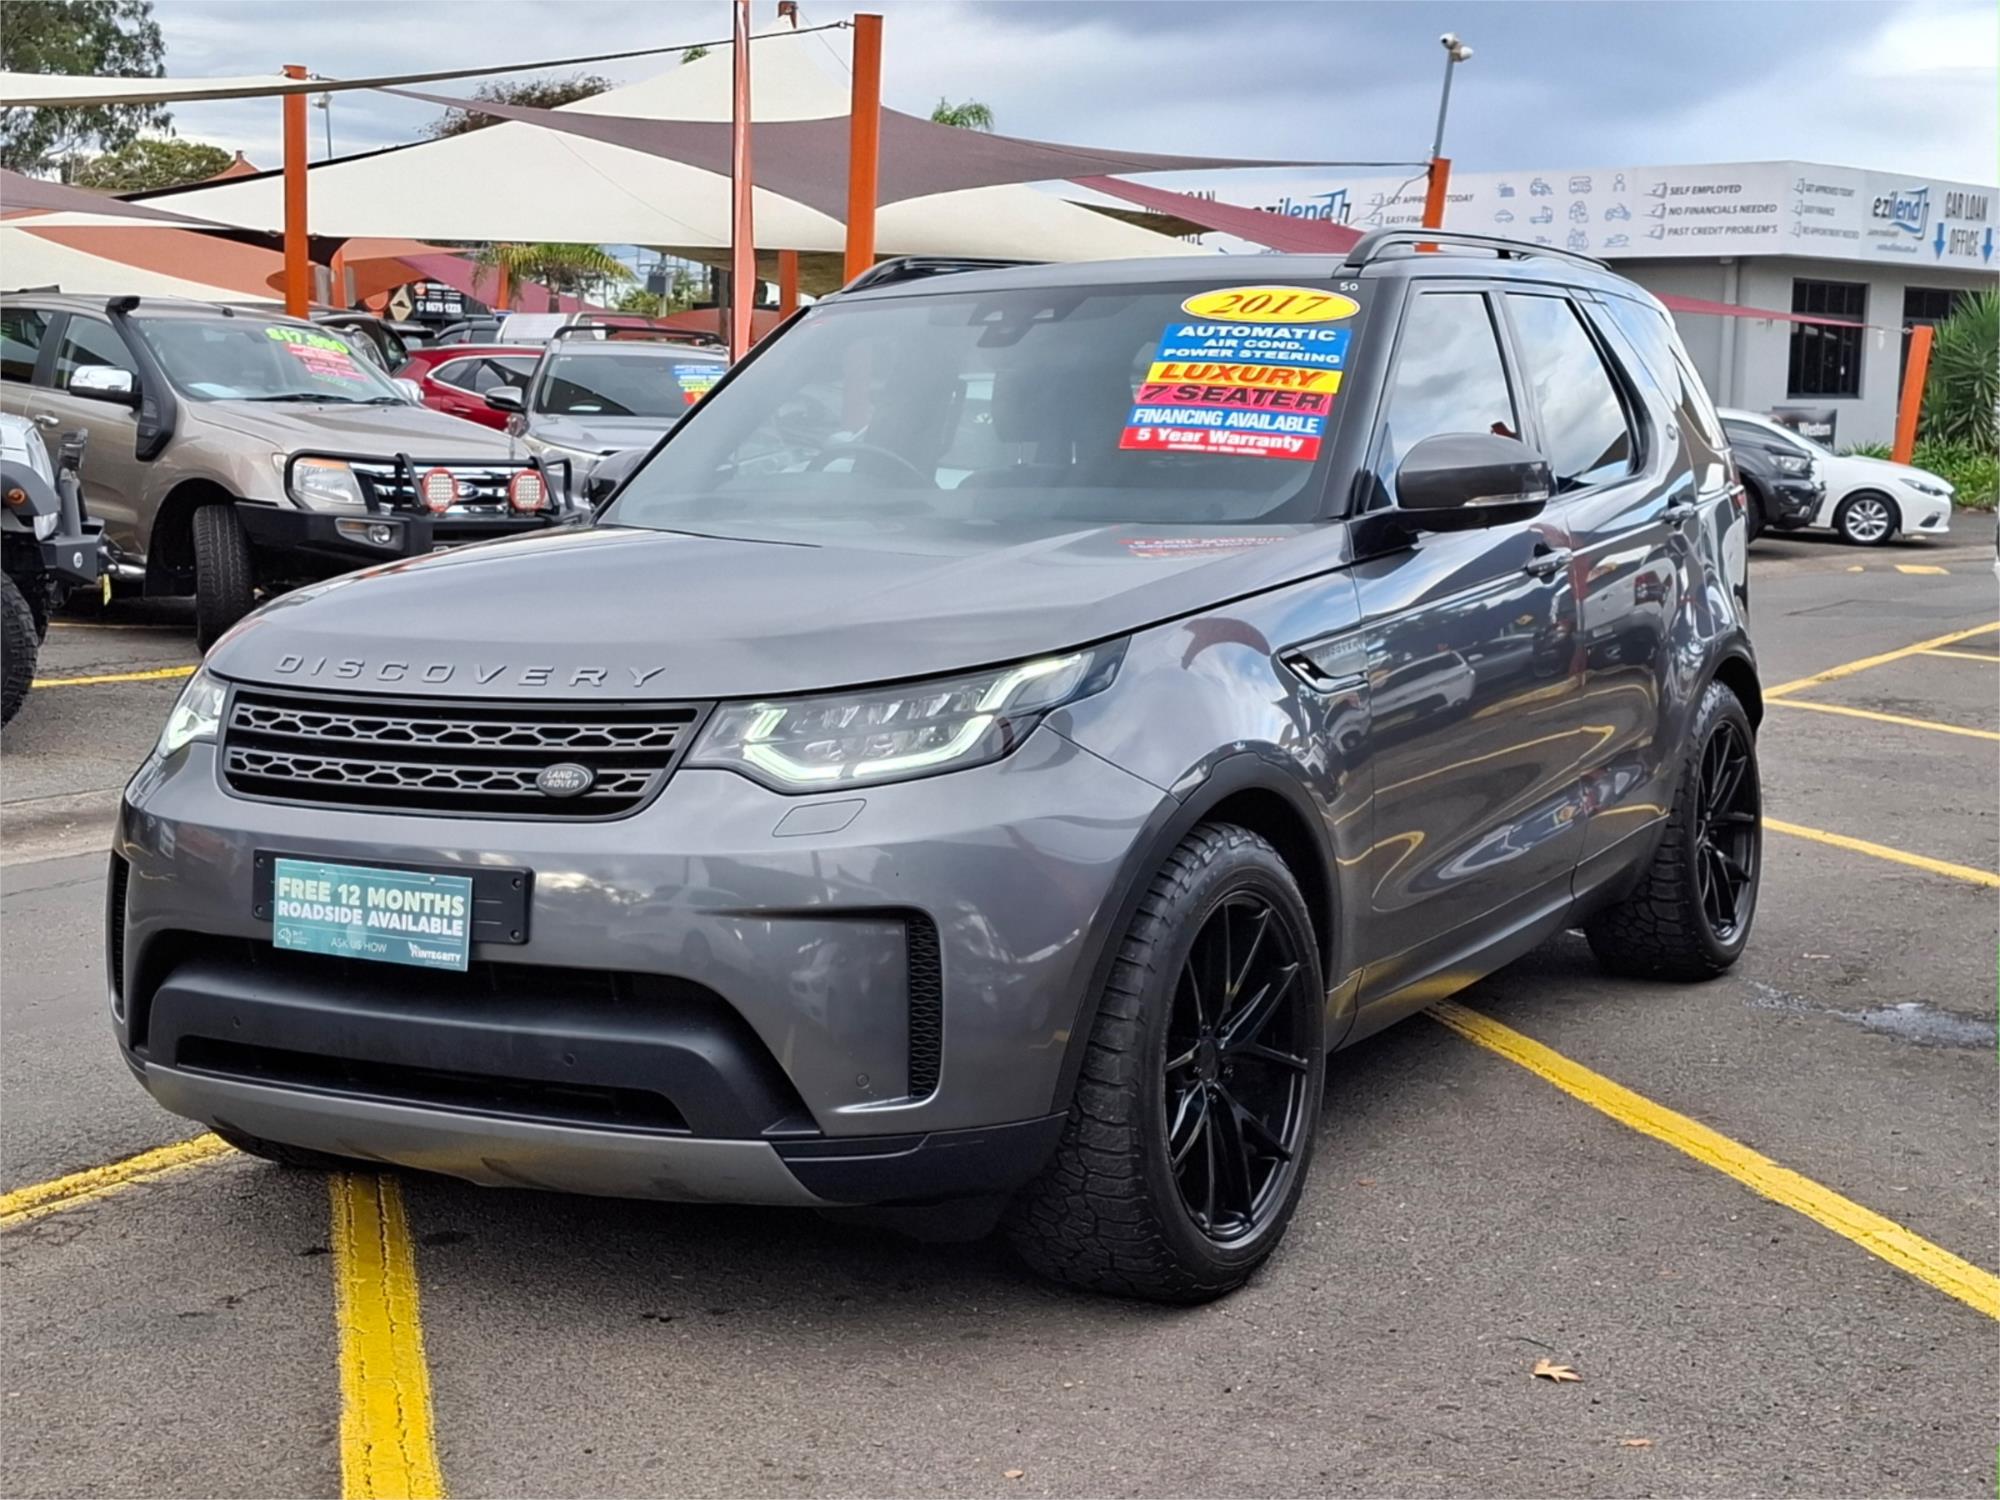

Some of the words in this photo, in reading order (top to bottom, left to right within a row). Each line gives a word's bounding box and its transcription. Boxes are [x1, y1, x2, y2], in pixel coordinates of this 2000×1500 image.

[1446, 194, 1474, 203] TODAY
[1670, 186, 1690, 196] SELF
[1692, 184, 1742, 195] EMPLOYED
[1668, 206, 1682, 216] NO
[1684, 205, 1738, 215] FINANCIALS
[1739, 204, 1778, 214] NEEDED
[1945, 191, 1963, 219] CAR
[1965, 193, 1989, 221] LOAN
[1667, 226, 1690, 236] PAST
[1691, 225, 1724, 236] CREDIT
[1724, 224, 1778, 235] PROBLEM'S
[1948, 228, 1980, 257] OFFICE
[1208, 294, 1333, 315] 2017
[1176, 325, 1337, 341] AUTOMATIC
[1203, 339, 1238, 348] AIR
[1243, 339, 1305, 351] COND.
[1162, 348, 1233, 358] POWER
[1238, 349, 1341, 364] STEERING
[1158, 363, 1329, 387] LUXURY
[1140, 385, 1171, 402] 7
[1172, 385, 1325, 409] SEATER
[1132, 408, 1223, 426] FINANCING
[1225, 411, 1320, 434] AVAILABLE
[1136, 428, 1152, 441] 5
[1157, 428, 1204, 443] Year
[1208, 429, 1304, 452] Warranty
[273, 653, 666, 688] DISCOVERY
[546, 770, 573, 780] LAND
[547, 779, 580, 789] ROVER
[277, 876, 331, 903] FREE
[337, 883, 361, 907] 12
[367, 887, 465, 918] MONTHS
[277, 900, 363, 926] ROADSIDE
[367, 911, 464, 937] AVAILABLE
[330, 937, 349, 949] ASK
[363, 941, 388, 953] HOW
